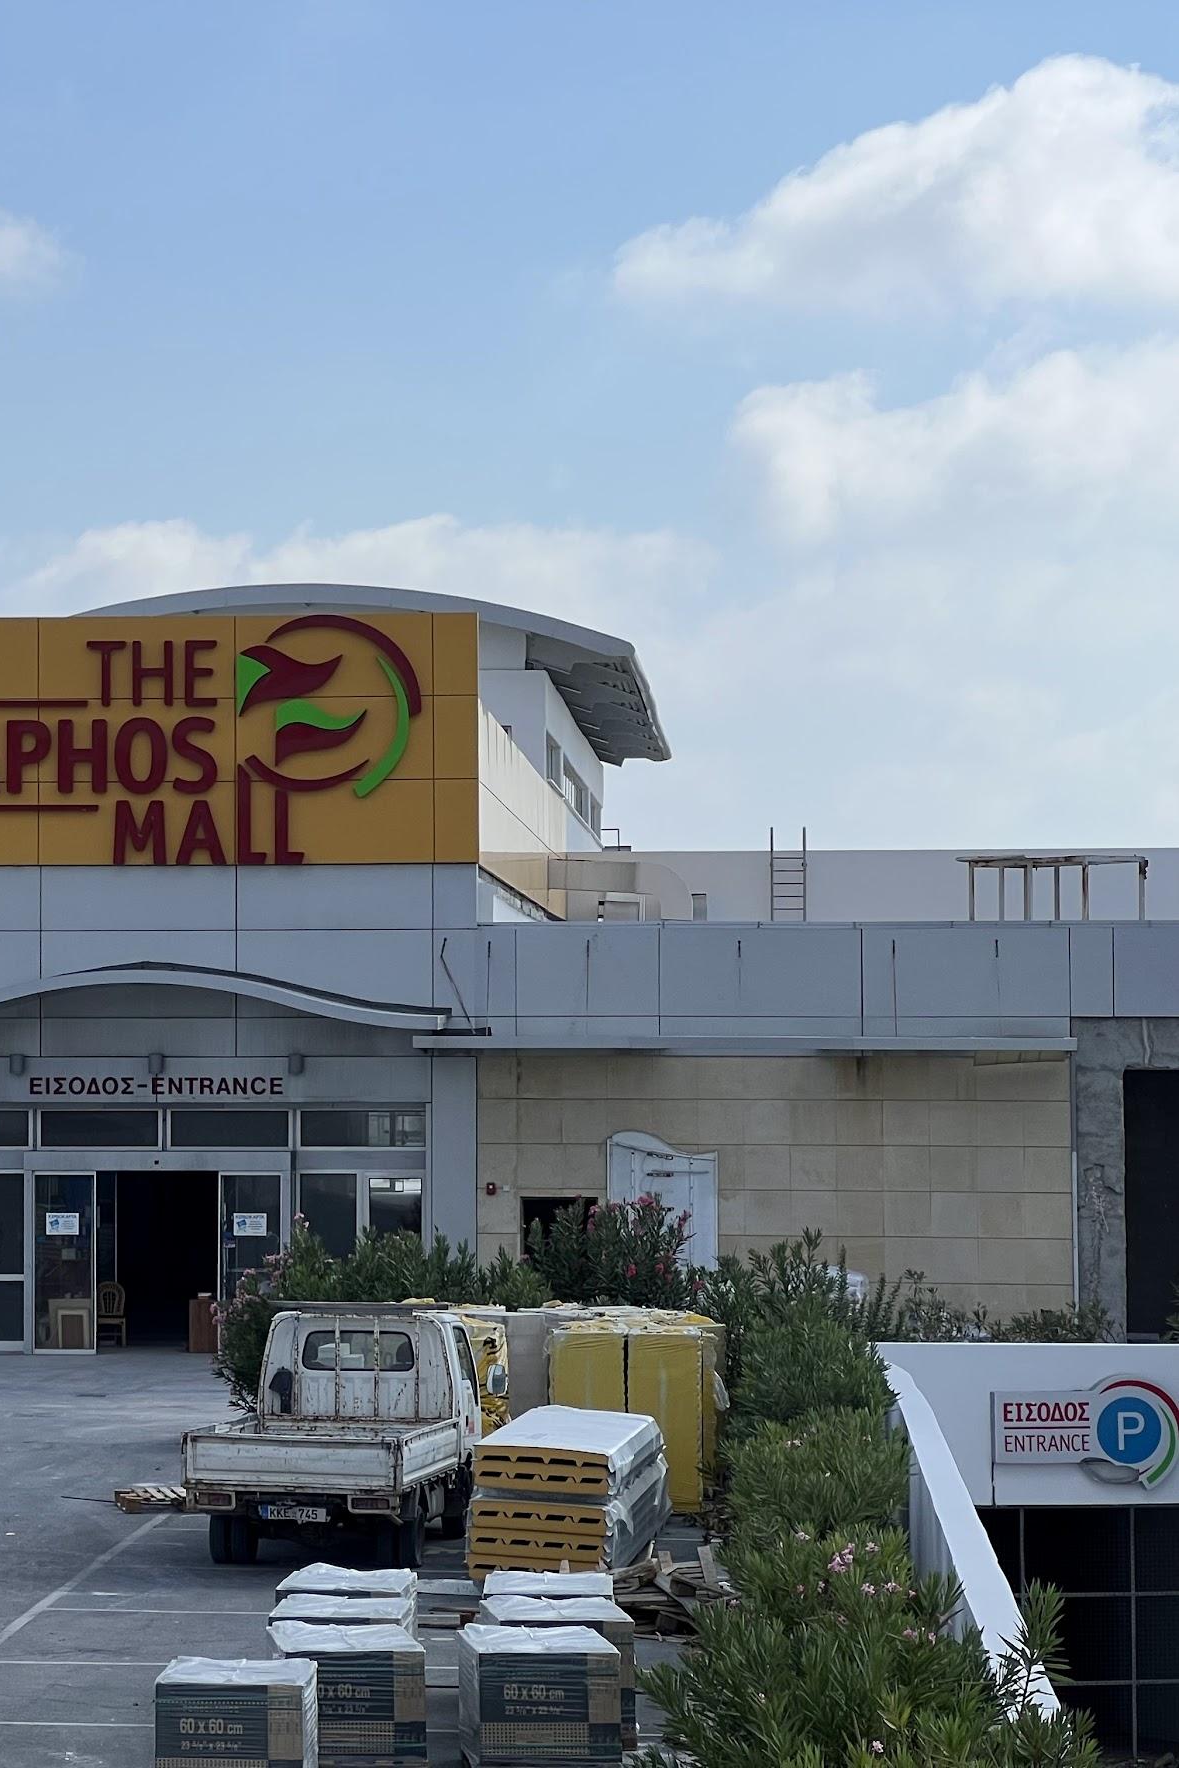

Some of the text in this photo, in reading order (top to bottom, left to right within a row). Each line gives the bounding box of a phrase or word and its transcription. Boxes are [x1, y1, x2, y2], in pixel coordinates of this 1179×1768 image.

[86, 640, 218, 707] THE
[112, 763, 306, 866] MALL
[1003, 1402, 1090, 1423] ΕΙΣΟΔΟΣ
[1117, 1411, 1145, 1451] P
[1004, 1434, 1091, 1453] ENTRANCE
[269, 1507, 318, 1520] KKE 745
[337, 1683, 353, 1699] 60
[503, 1684, 519, 1700] 60
[531, 1684, 546, 1700] 60
[179, 1718, 195, 1734] 60
[208, 1718, 224, 1734] 60
[226, 1724, 243, 1735] cm
